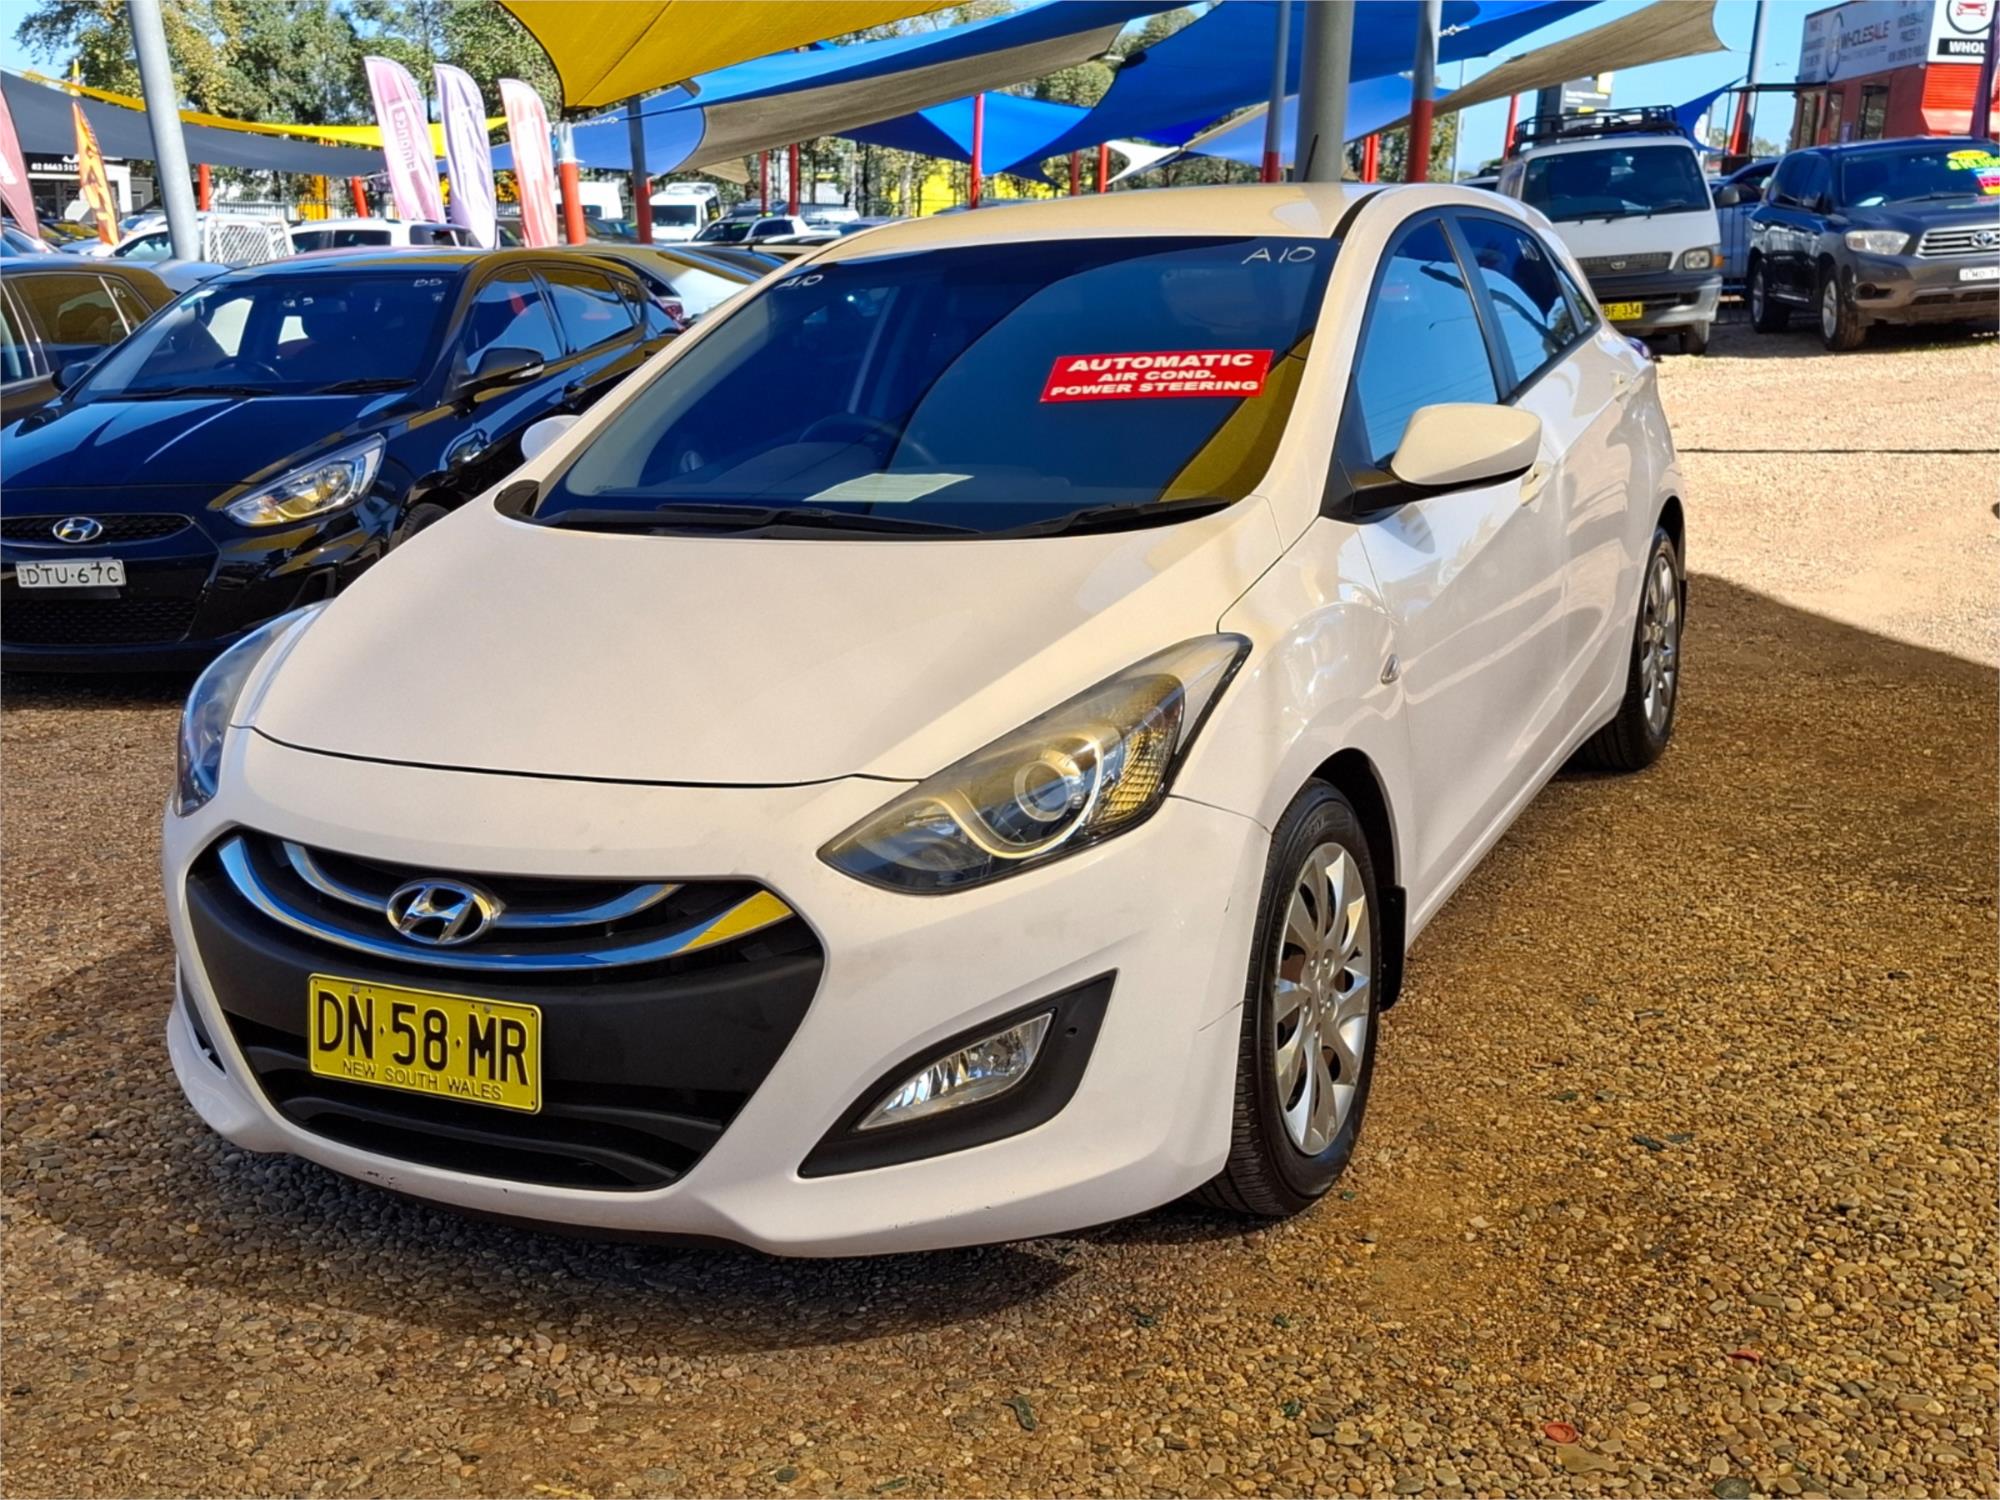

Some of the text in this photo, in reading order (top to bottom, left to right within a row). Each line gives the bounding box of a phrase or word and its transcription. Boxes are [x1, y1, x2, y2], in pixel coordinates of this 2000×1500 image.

[1241, 246, 1316, 265] A10
[1600, 304, 1618, 318] BF
[1067, 353, 1255, 372] AUTOMATIC
[1098, 369, 1217, 383] AIR COND.
[1050, 381, 1259, 396] POWER STEERING
[342, 1058, 503, 1101] NEW SOUTH WALES
